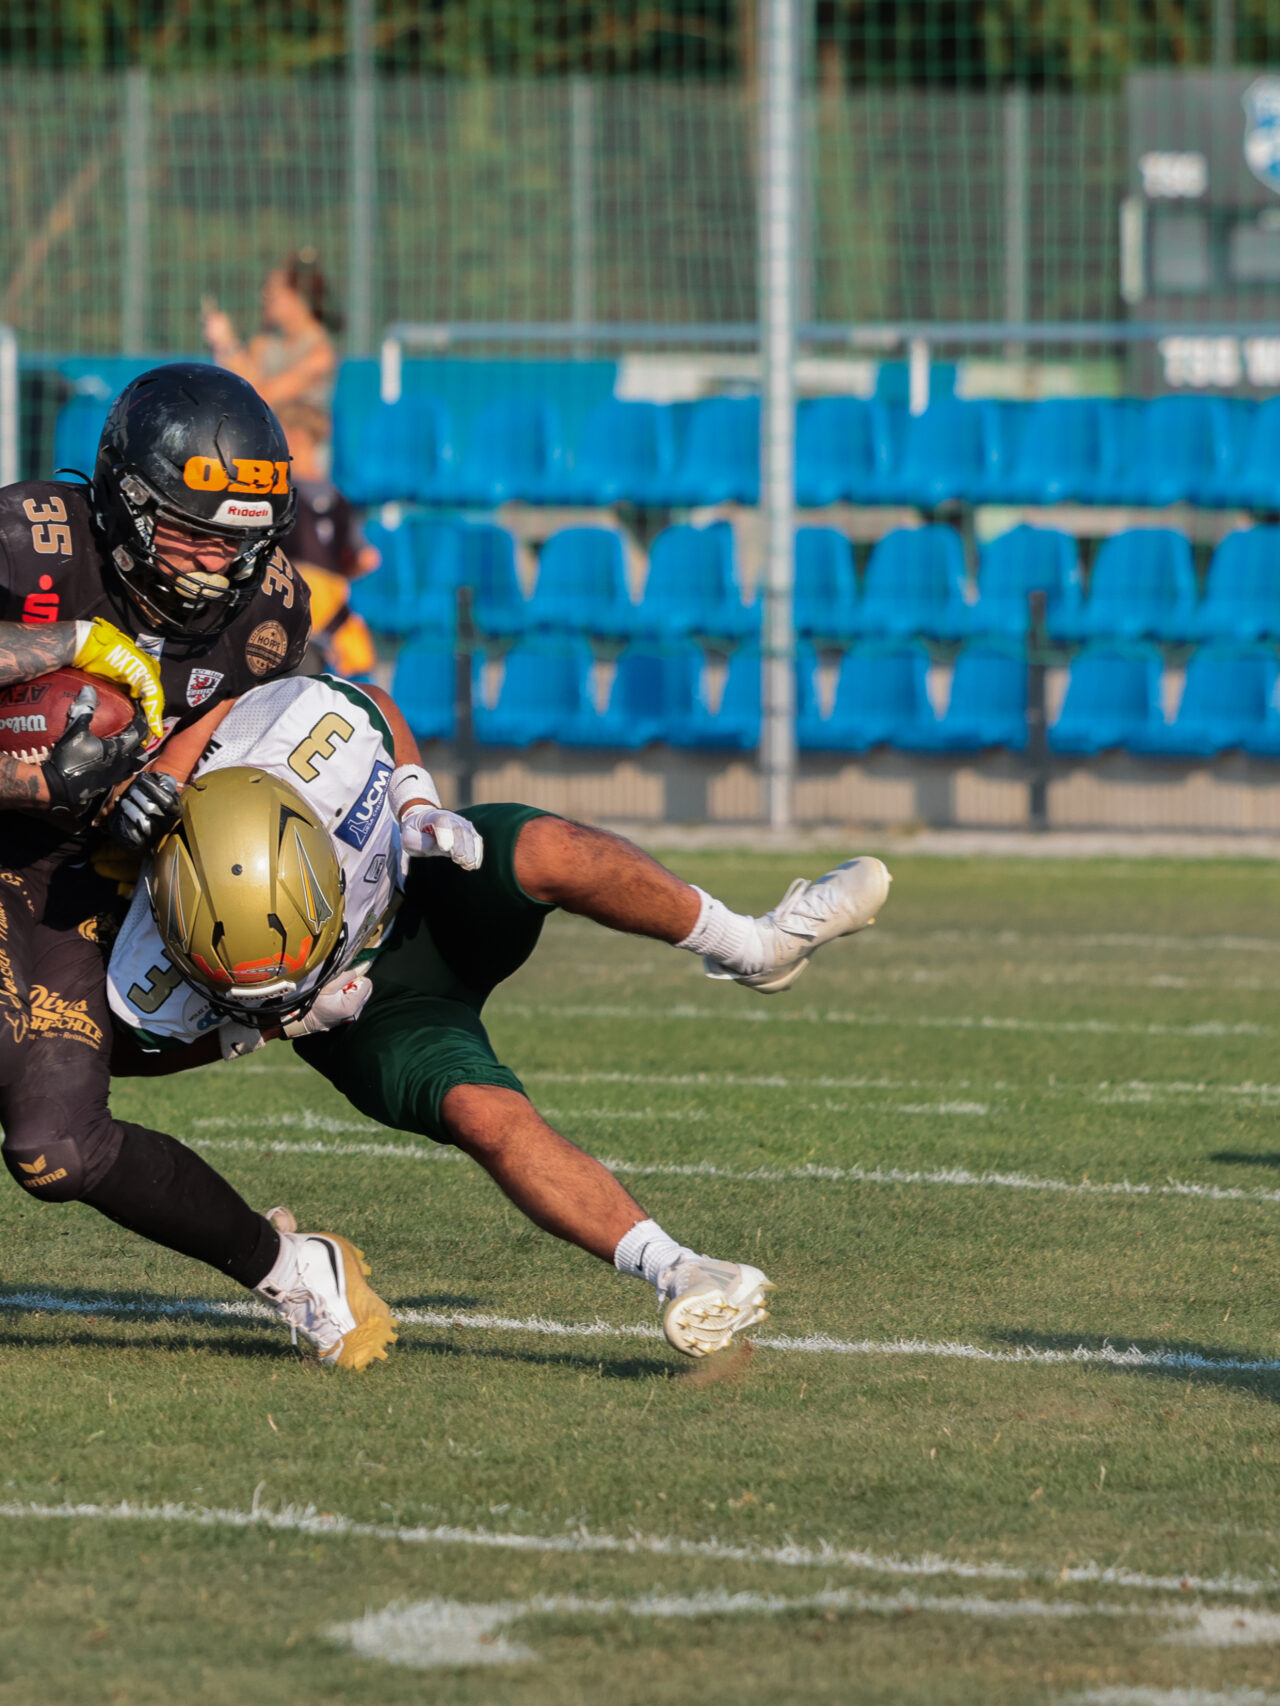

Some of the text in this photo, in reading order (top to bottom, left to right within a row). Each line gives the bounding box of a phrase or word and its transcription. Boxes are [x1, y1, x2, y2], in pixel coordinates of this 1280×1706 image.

[183, 455, 290, 494] OBI
[22, 495, 74, 556] 35
[226, 504, 270, 518] Riddell
[260, 545, 296, 610] 35
[288, 711, 355, 783] 3
[355, 769, 389, 821] UCM
[23, 1167, 68, 1188] erima
